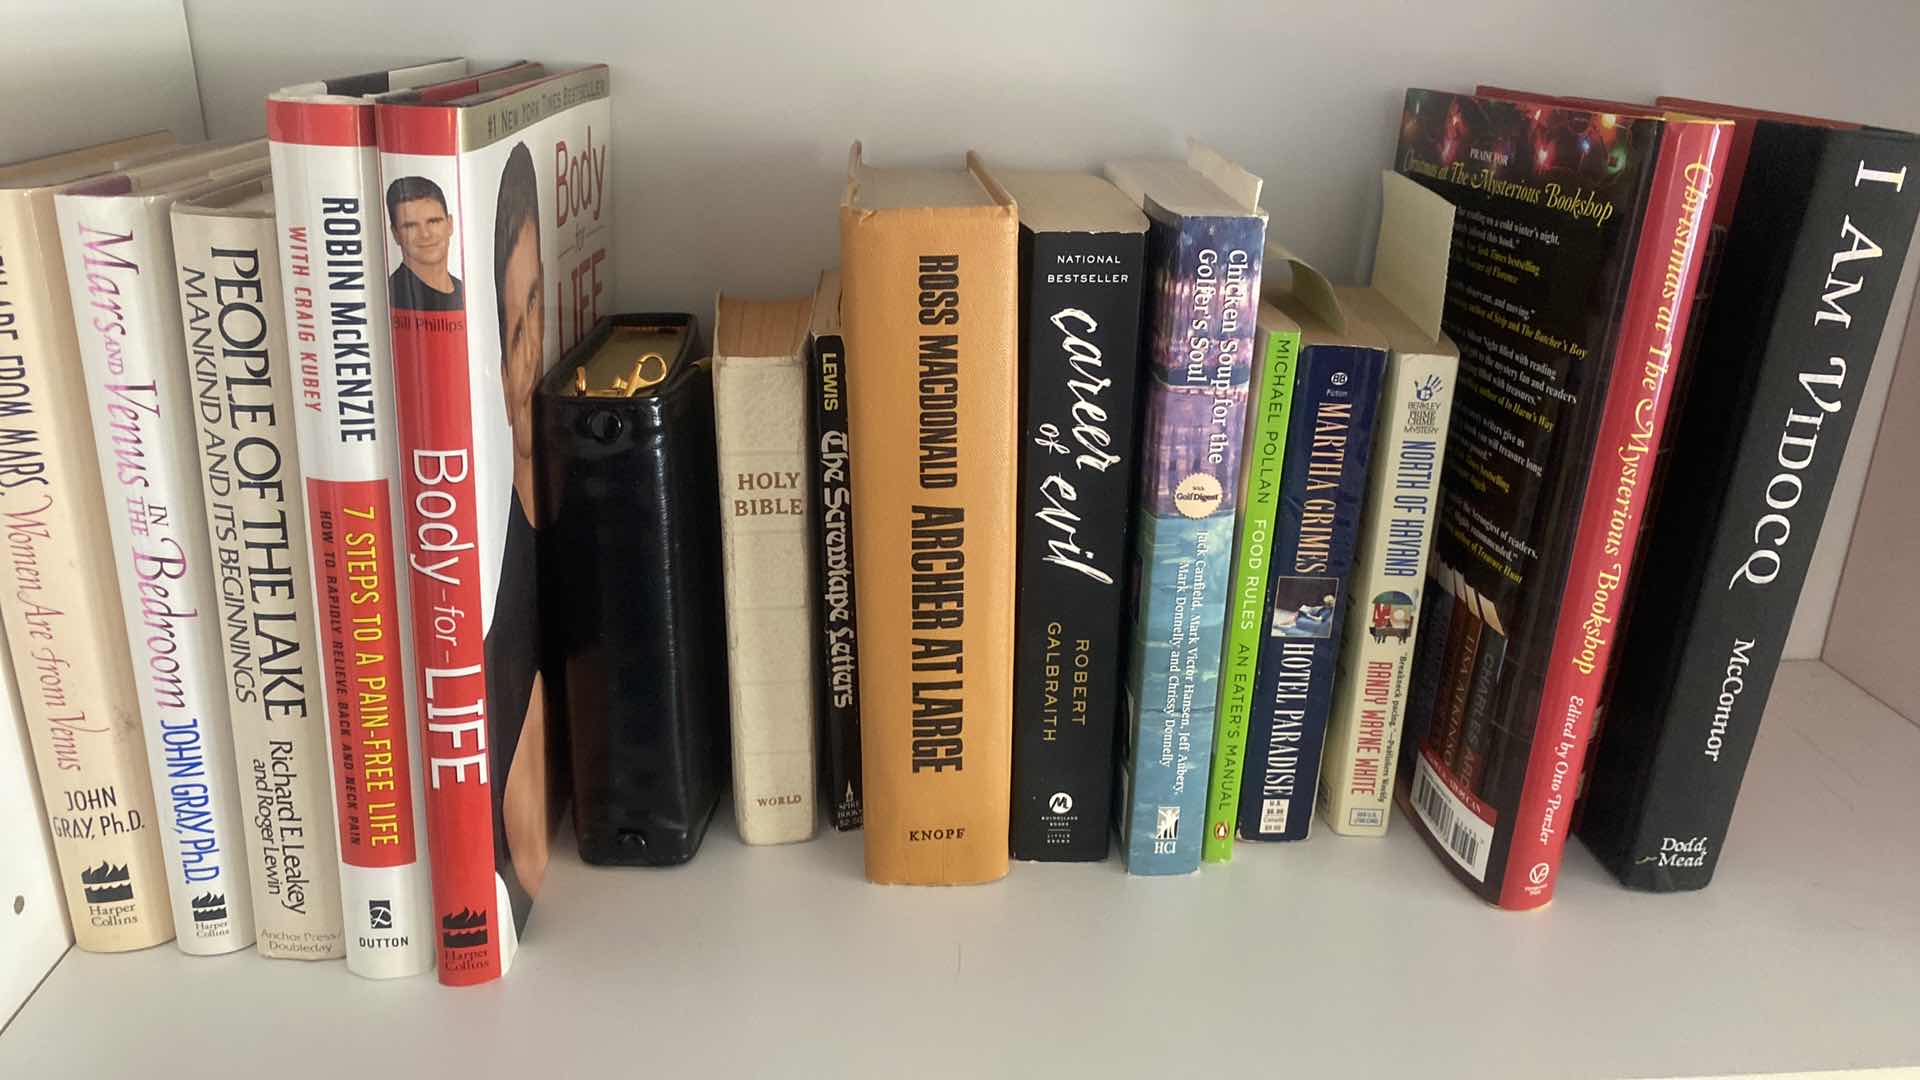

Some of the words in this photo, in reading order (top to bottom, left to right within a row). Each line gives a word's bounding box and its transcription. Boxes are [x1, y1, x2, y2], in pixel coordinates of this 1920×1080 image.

[555, 124, 606, 228] Body
[1451, 160, 1471, 186] The
[1471, 168, 1542, 205] Mysterious
[1545, 183, 1614, 228] Bookshop
[1854, 159, 1908, 193] I
[287, 226, 312, 277] WITH
[320, 196, 366, 292] ROBIN
[1662, 153, 1714, 300] Christmas
[78, 222, 141, 337] Mars
[1047, 274, 1129, 284] BESTSELLER
[1056, 254, 1121, 265] NATIONAL
[1814, 213, 1884, 330] AM
[294, 286, 317, 343] CRAIG
[557, 247, 606, 361] LIFE
[919, 254, 960, 326] ROSS
[1192, 248, 1218, 331] Golfer's
[1220, 249, 1249, 333] Chicken
[182, 265, 223, 425] MANKIND
[210, 246, 277, 432] PEOPLE
[393, 316, 412, 331] Bill
[415, 317, 465, 333] Phillips
[1655, 305, 1674, 334] at
[102, 335, 125, 376] AND
[1186, 335, 1209, 385] Soul
[1210, 339, 1239, 392] Soup
[1568, 342, 1589, 361] Boy
[1641, 342, 1673, 392] The
[299, 350, 324, 414] KUBEY
[822, 352, 840, 412] LEWIS
[1050, 307, 1121, 472] career
[1266, 339, 1291, 423] MICHAEL
[1531, 379, 1544, 393] and
[102, 379, 161, 488] Venus
[918, 334, 960, 489] MACDONALD
[1210, 391, 1234, 426] for
[204, 427, 232, 498] AND
[820, 430, 848, 483] The
[1034, 422, 1071, 455] of
[1208, 430, 1231, 465] the
[1306, 402, 1353, 492] MARTHA
[232, 435, 286, 504] OF
[737, 471, 801, 491] HOLY
[1256, 431, 1280, 504] POLLAN
[1395, 440, 1437, 491] NORTH
[1603, 398, 1655, 558] Mysterious
[1727, 356, 1848, 592] VIDOCQ
[126, 496, 150, 537] THE
[147, 503, 170, 528] IN
[211, 502, 238, 542] ITS
[343, 505, 376, 520] 7
[410, 448, 476, 586] Body
[734, 498, 804, 517] BIBLE
[1176, 492, 1193, 501] Golf
[1393, 495, 1428, 515] OF
[2, 493, 53, 592] Women
[320, 510, 335, 545] HOW
[1034, 472, 1114, 585] evil
[1196, 529, 1209, 558] Jack
[1248, 519, 1267, 570] FOOD
[1294, 498, 1337, 574] GRIMES
[1384, 519, 1425, 578] HAVANA
[241, 509, 296, 605] THE
[323, 551, 337, 569] TO
[344, 532, 381, 606] STEPS
[823, 486, 851, 623] Screwtape
[911, 504, 965, 631] ARCHER
[1175, 560, 1190, 594] Mark
[326, 575, 344, 635] RAPIDLY
[1190, 560, 1207, 612] Canfield,
[1240, 576, 1260, 631] RULES
[17, 590, 65, 640] Are
[131, 537, 199, 710] Bedroom
[217, 547, 258, 704] BEGINNINGS
[351, 613, 383, 642] TO
[1168, 597, 1187, 650] Donnelly
[1187, 614, 1202, 645] Mark
[1571, 562, 1622, 676] Bookshop
[31, 647, 71, 708] from
[252, 611, 308, 721] LAKE
[332, 640, 350, 696] RELIEVE
[354, 651, 385, 666] A
[830, 625, 855, 709] Letters
[911, 637, 964, 674] AT
[1168, 650, 1181, 674] and
[1185, 648, 1199, 683] Victor
[1233, 643, 1251, 667] AN
[1275, 642, 1316, 704] HOTEL
[1043, 621, 1063, 742] GALBRAITH
[1071, 638, 1090, 727] ROBERT
[1163, 675, 1181, 717] Chrissy
[1179, 684, 1196, 729] Hansen,
[1226, 672, 1249, 738] EATER'S
[1362, 660, 1393, 706] RANDY
[1703, 637, 1756, 763] McConnor
[48, 710, 110, 772] Venus
[337, 702, 352, 737] BACK
[356, 675, 396, 794] PAIN-FREE
[425, 662, 488, 791] LIFE
[911, 679, 964, 774] LARGE
[1356, 708, 1387, 755] WAYNE
[1565, 694, 1585, 738] Edited
[160, 718, 205, 777] JOHN
[341, 743, 355, 772] AND
[1159, 719, 1176, 768] Donnelly
[1177, 731, 1191, 753] Jeff
[1263, 709, 1305, 797] PARADISE
[1554, 737, 1578, 757] by
[64, 785, 117, 812] JOHN
[252, 758, 274, 794] and
[269, 740, 304, 824] Richard
[344, 775, 359, 810] NECK
[757, 794, 803, 808] WORLD
[1218, 744, 1240, 811] MANUAL
[1351, 756, 1380, 796] WHITE
[1551, 759, 1570, 792] Otto
[53, 814, 97, 840] GRAY,
[100, 808, 146, 835] Ph.D.
[169, 782, 214, 836] GRAY,
[254, 793, 275, 847] Roger
[280, 824, 304, 843] E.
[348, 815, 362, 847] PAIN
[367, 801, 400, 849] LIFE
[1539, 793, 1563, 847] Penzler
[909, 828, 966, 842] KNOPF
[1154, 842, 1178, 855] HCI
[1656, 850, 1707, 868] Mead
[1660, 836, 1709, 858] Dodd,
[177, 837, 221, 886] Ph.D.
[263, 845, 285, 896] Lewin
[281, 844, 311, 917] Leakey
[88, 902, 137, 920] Harper
[89, 913, 139, 928] Collins
[194, 919, 230, 932] Harper
[260, 928, 301, 943] Anchor
[268, 939, 334, 954] Doubleday
[359, 936, 409, 949] DUTTON
[443, 946, 490, 964] Harper
[444, 958, 491, 975] Collins
